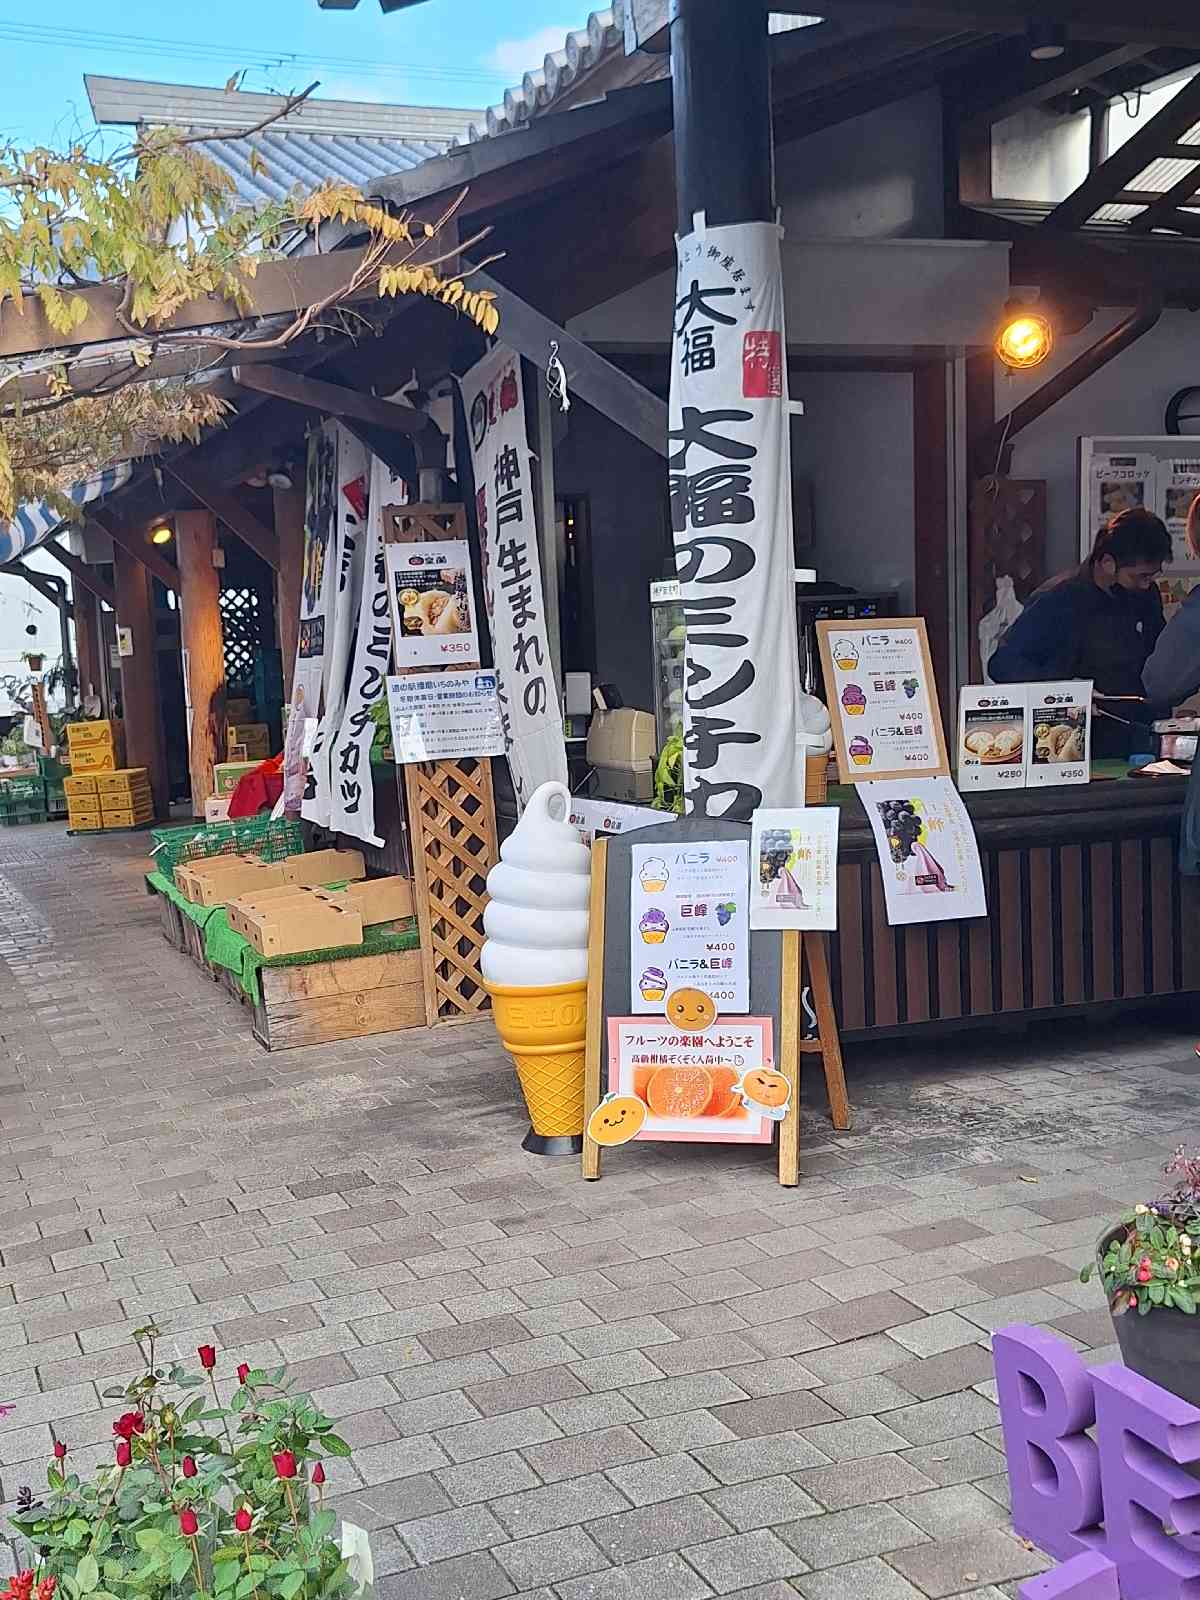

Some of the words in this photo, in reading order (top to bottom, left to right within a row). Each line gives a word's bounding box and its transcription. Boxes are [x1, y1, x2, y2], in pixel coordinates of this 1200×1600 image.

[673, 279, 737, 377] 大福
[861, 635, 889, 646] バニラ
[441, 643, 471, 653] ¥350
[899, 712, 923, 720] ¥400
[871, 724, 924, 737] バニラ&巨峰
[904, 753, 929, 761] ¥400
[674, 852, 711, 865] バニラ
[680, 903, 708, 918] 巨峰
[706, 942, 736, 951] ¥400
[668, 957, 734, 970] バニラ&巨峰
[624, 1034, 755, 1049] フルーツの楽園へようこそ
